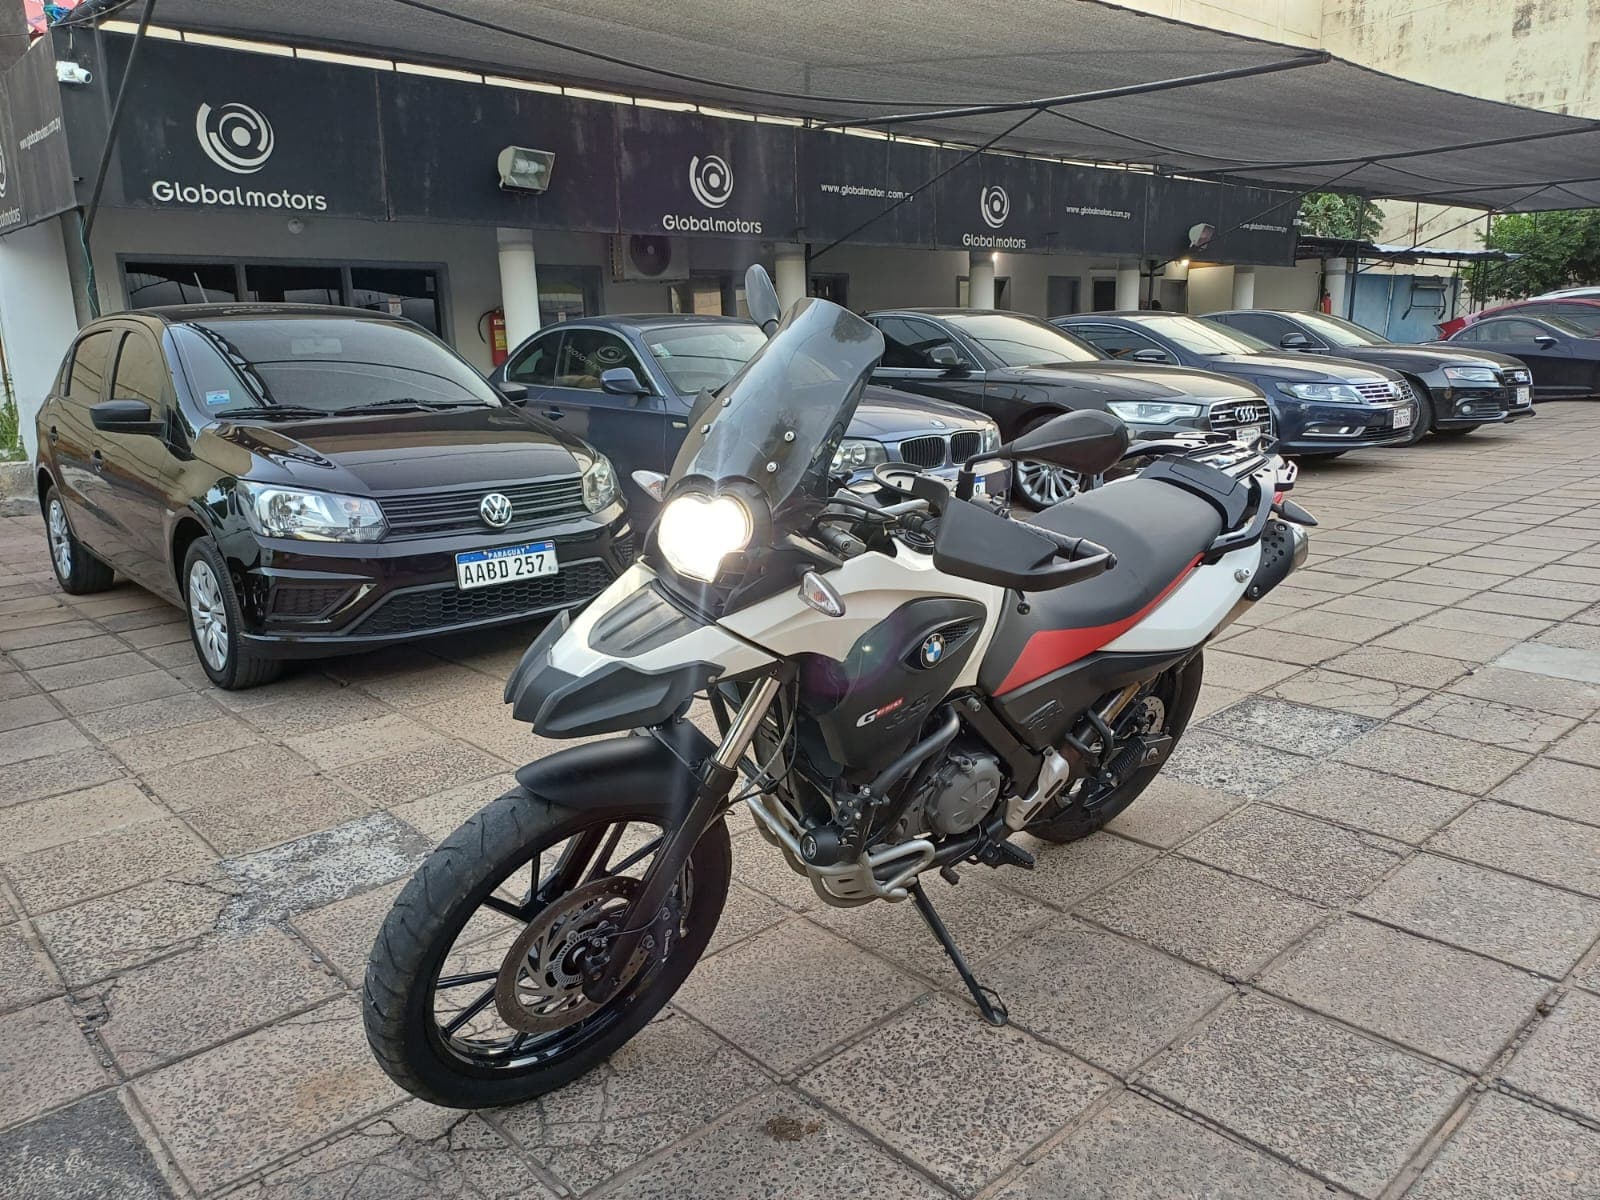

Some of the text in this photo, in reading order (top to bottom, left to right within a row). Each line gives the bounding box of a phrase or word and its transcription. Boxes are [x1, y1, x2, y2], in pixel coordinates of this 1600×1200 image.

[151, 180, 328, 211] Globalmotors
[662, 214, 762, 234] Globalmotors
[962, 233, 1026, 249] Globalmotors
[487, 547, 527, 559] PARAGUAY
[464, 554, 545, 584] AABD 257
